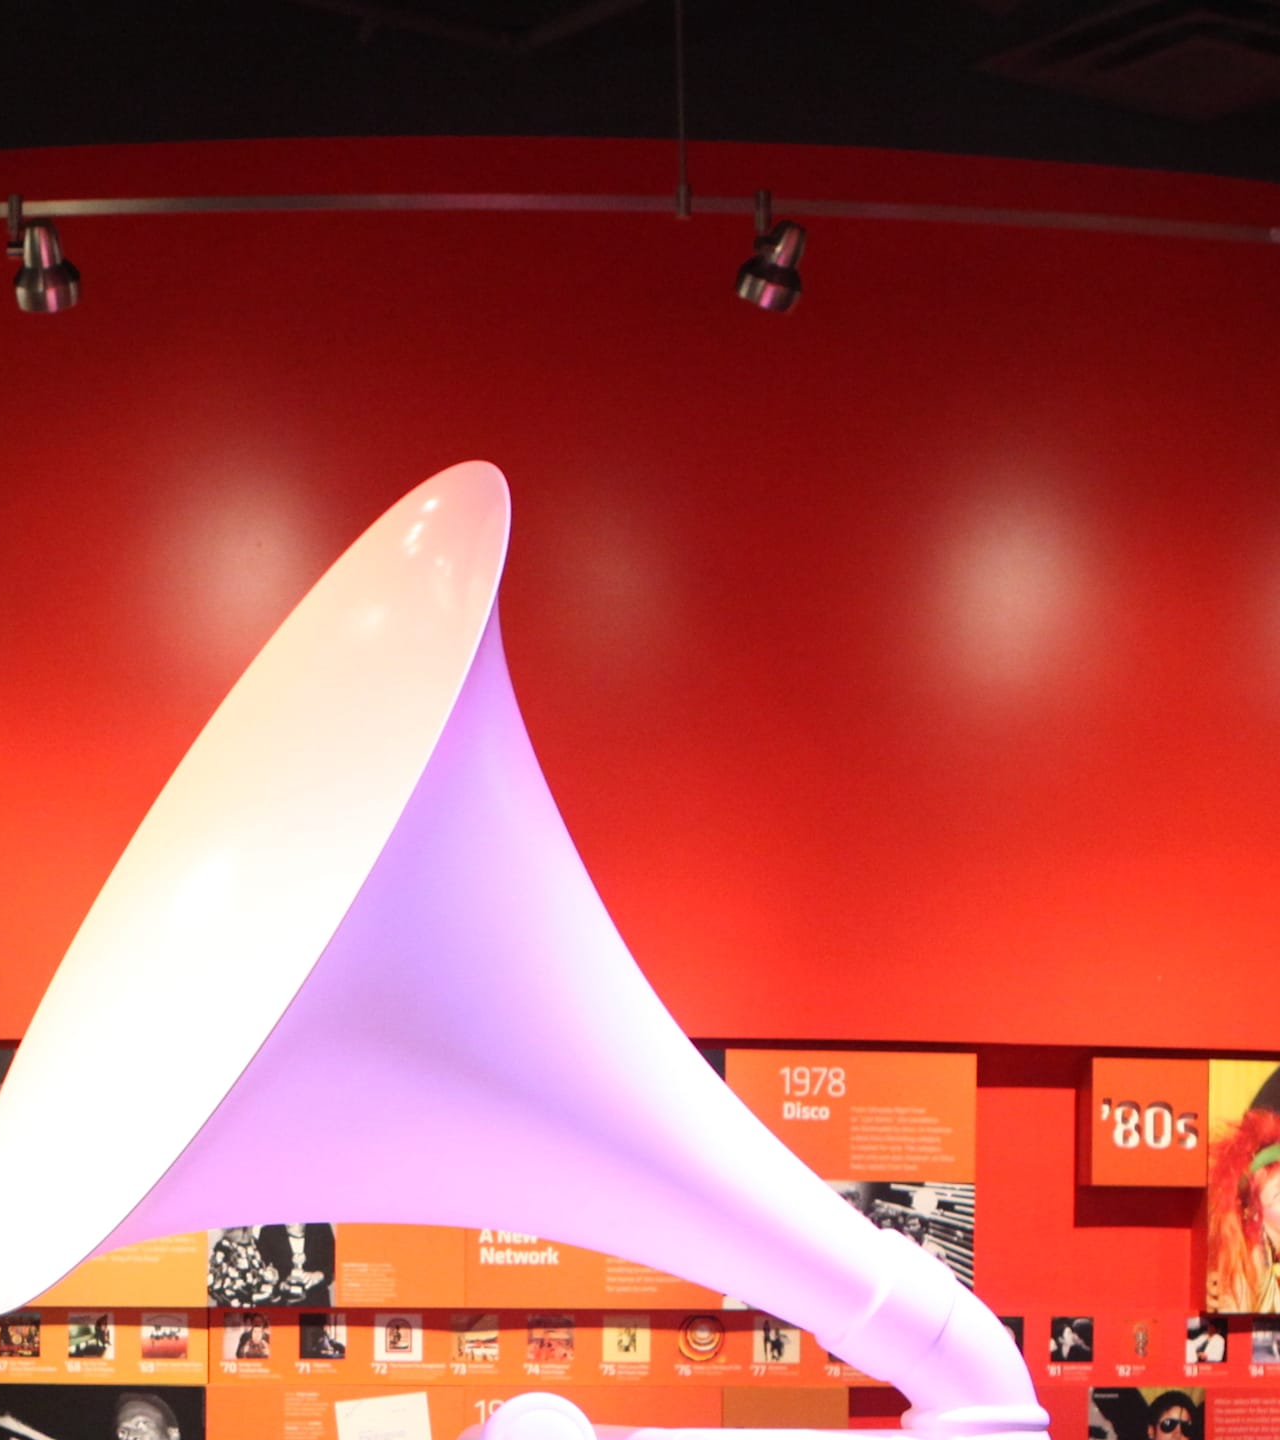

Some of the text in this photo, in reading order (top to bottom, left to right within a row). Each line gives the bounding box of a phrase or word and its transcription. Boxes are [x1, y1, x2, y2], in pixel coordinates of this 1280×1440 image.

[779, 1067, 846, 1097] 1978
[783, 1102, 830, 1120] Disco
[1100, 1099, 1199, 1150] '80s
[480, 1247, 559, 1265] Network
